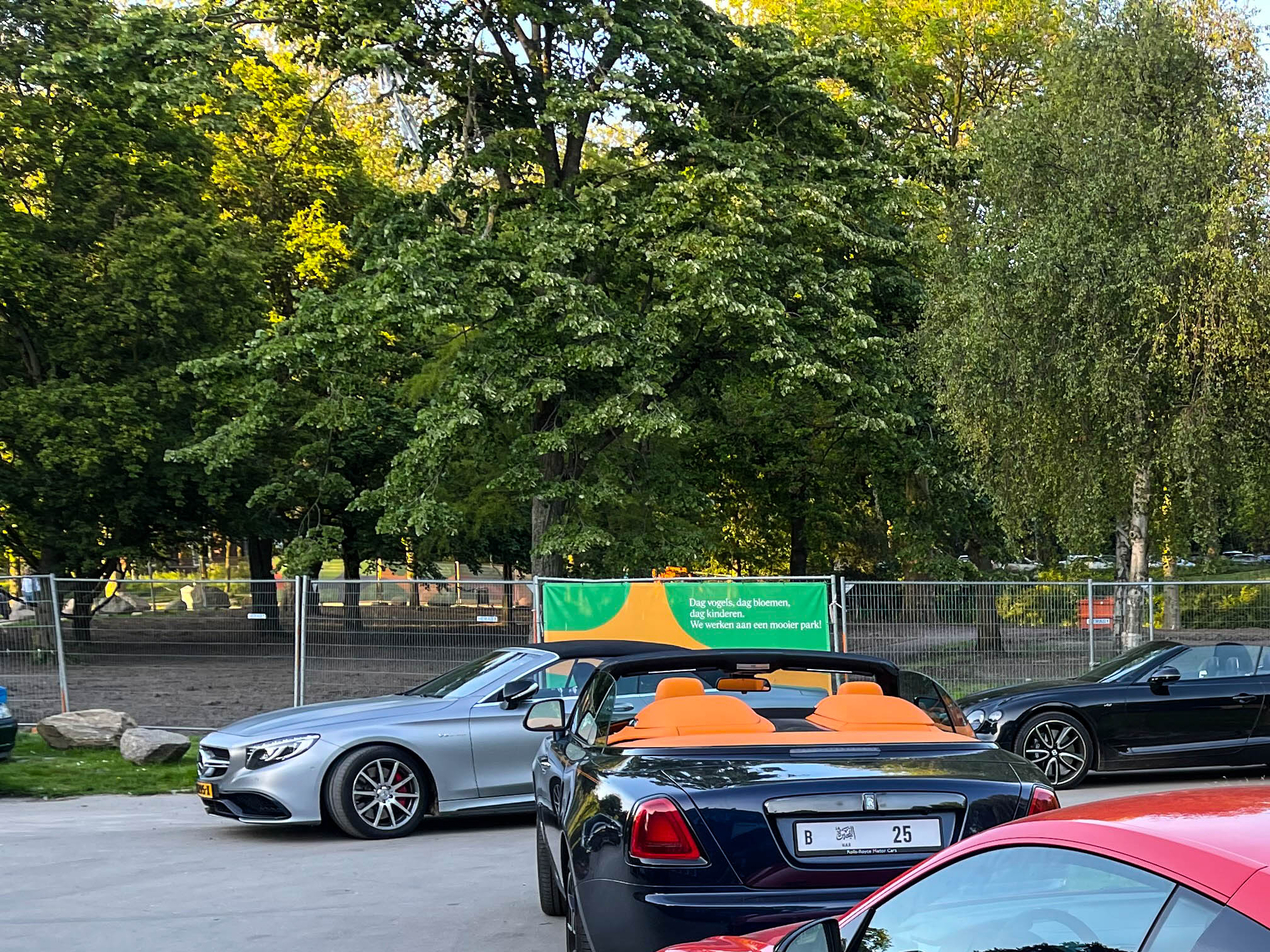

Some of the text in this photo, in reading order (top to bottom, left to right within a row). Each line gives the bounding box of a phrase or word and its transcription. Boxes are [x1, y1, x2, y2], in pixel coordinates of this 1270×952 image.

[689, 597, 791, 608] Dag vogels, dag bloemen,
[689, 608, 745, 619] dag kinderen.
[690, 620, 822, 630] We werken aan een mooier park!
[804, 825, 912, 845] B 25
